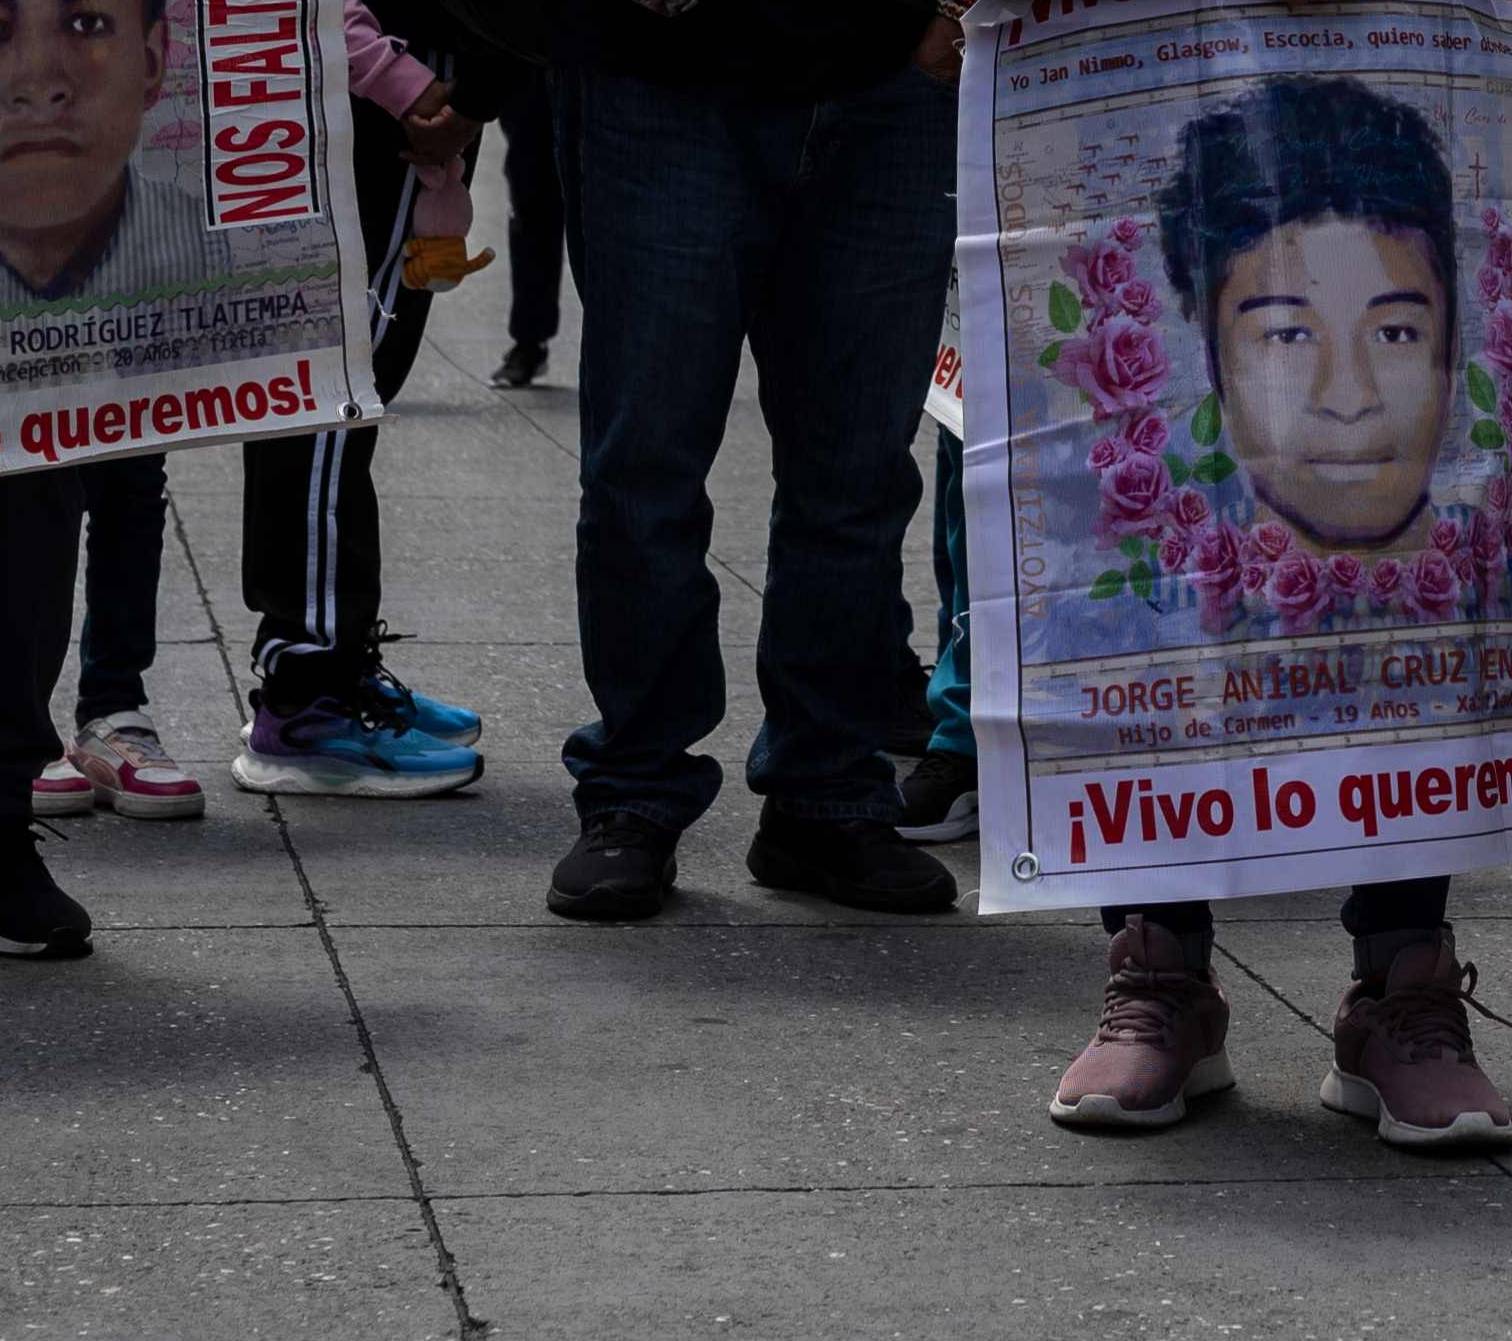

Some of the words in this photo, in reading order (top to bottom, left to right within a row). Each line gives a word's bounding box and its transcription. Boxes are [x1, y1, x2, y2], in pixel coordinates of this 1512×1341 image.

[1009, 74, 1030, 92] Yo
[1039, 66, 1069, 85] Jan
[1078, 53, 1144, 77] Nimmo,
[1156, 34, 1250, 63] Glasgow,
[1263, 28, 1354, 51] Escocia,
[1367, 28, 1425, 53] quiero
[1431, 31, 1472, 50] saber
[214, 119, 309, 224] NOS
[9, 311, 165, 356] RODRÍGUEZ
[180, 290, 310, 333] TLATEMPA
[113, 347, 133, 367] 20
[20, 359, 318, 462] queremos!
[1080, 675, 1196, 718] JORGE
[1222, 657, 1356, 705] ANÍBAL
[1380, 650, 1469, 690] CRUZ
[1116, 723, 1173, 747] Hijo
[1184, 715, 1212, 739] de
[1223, 710, 1296, 736] Carmen
[1334, 703, 1358, 725] 19
[1371, 699, 1420, 720] Años
[1067, 778, 1232, 864] ¡Vivo
[1252, 767, 1316, 832] lo
